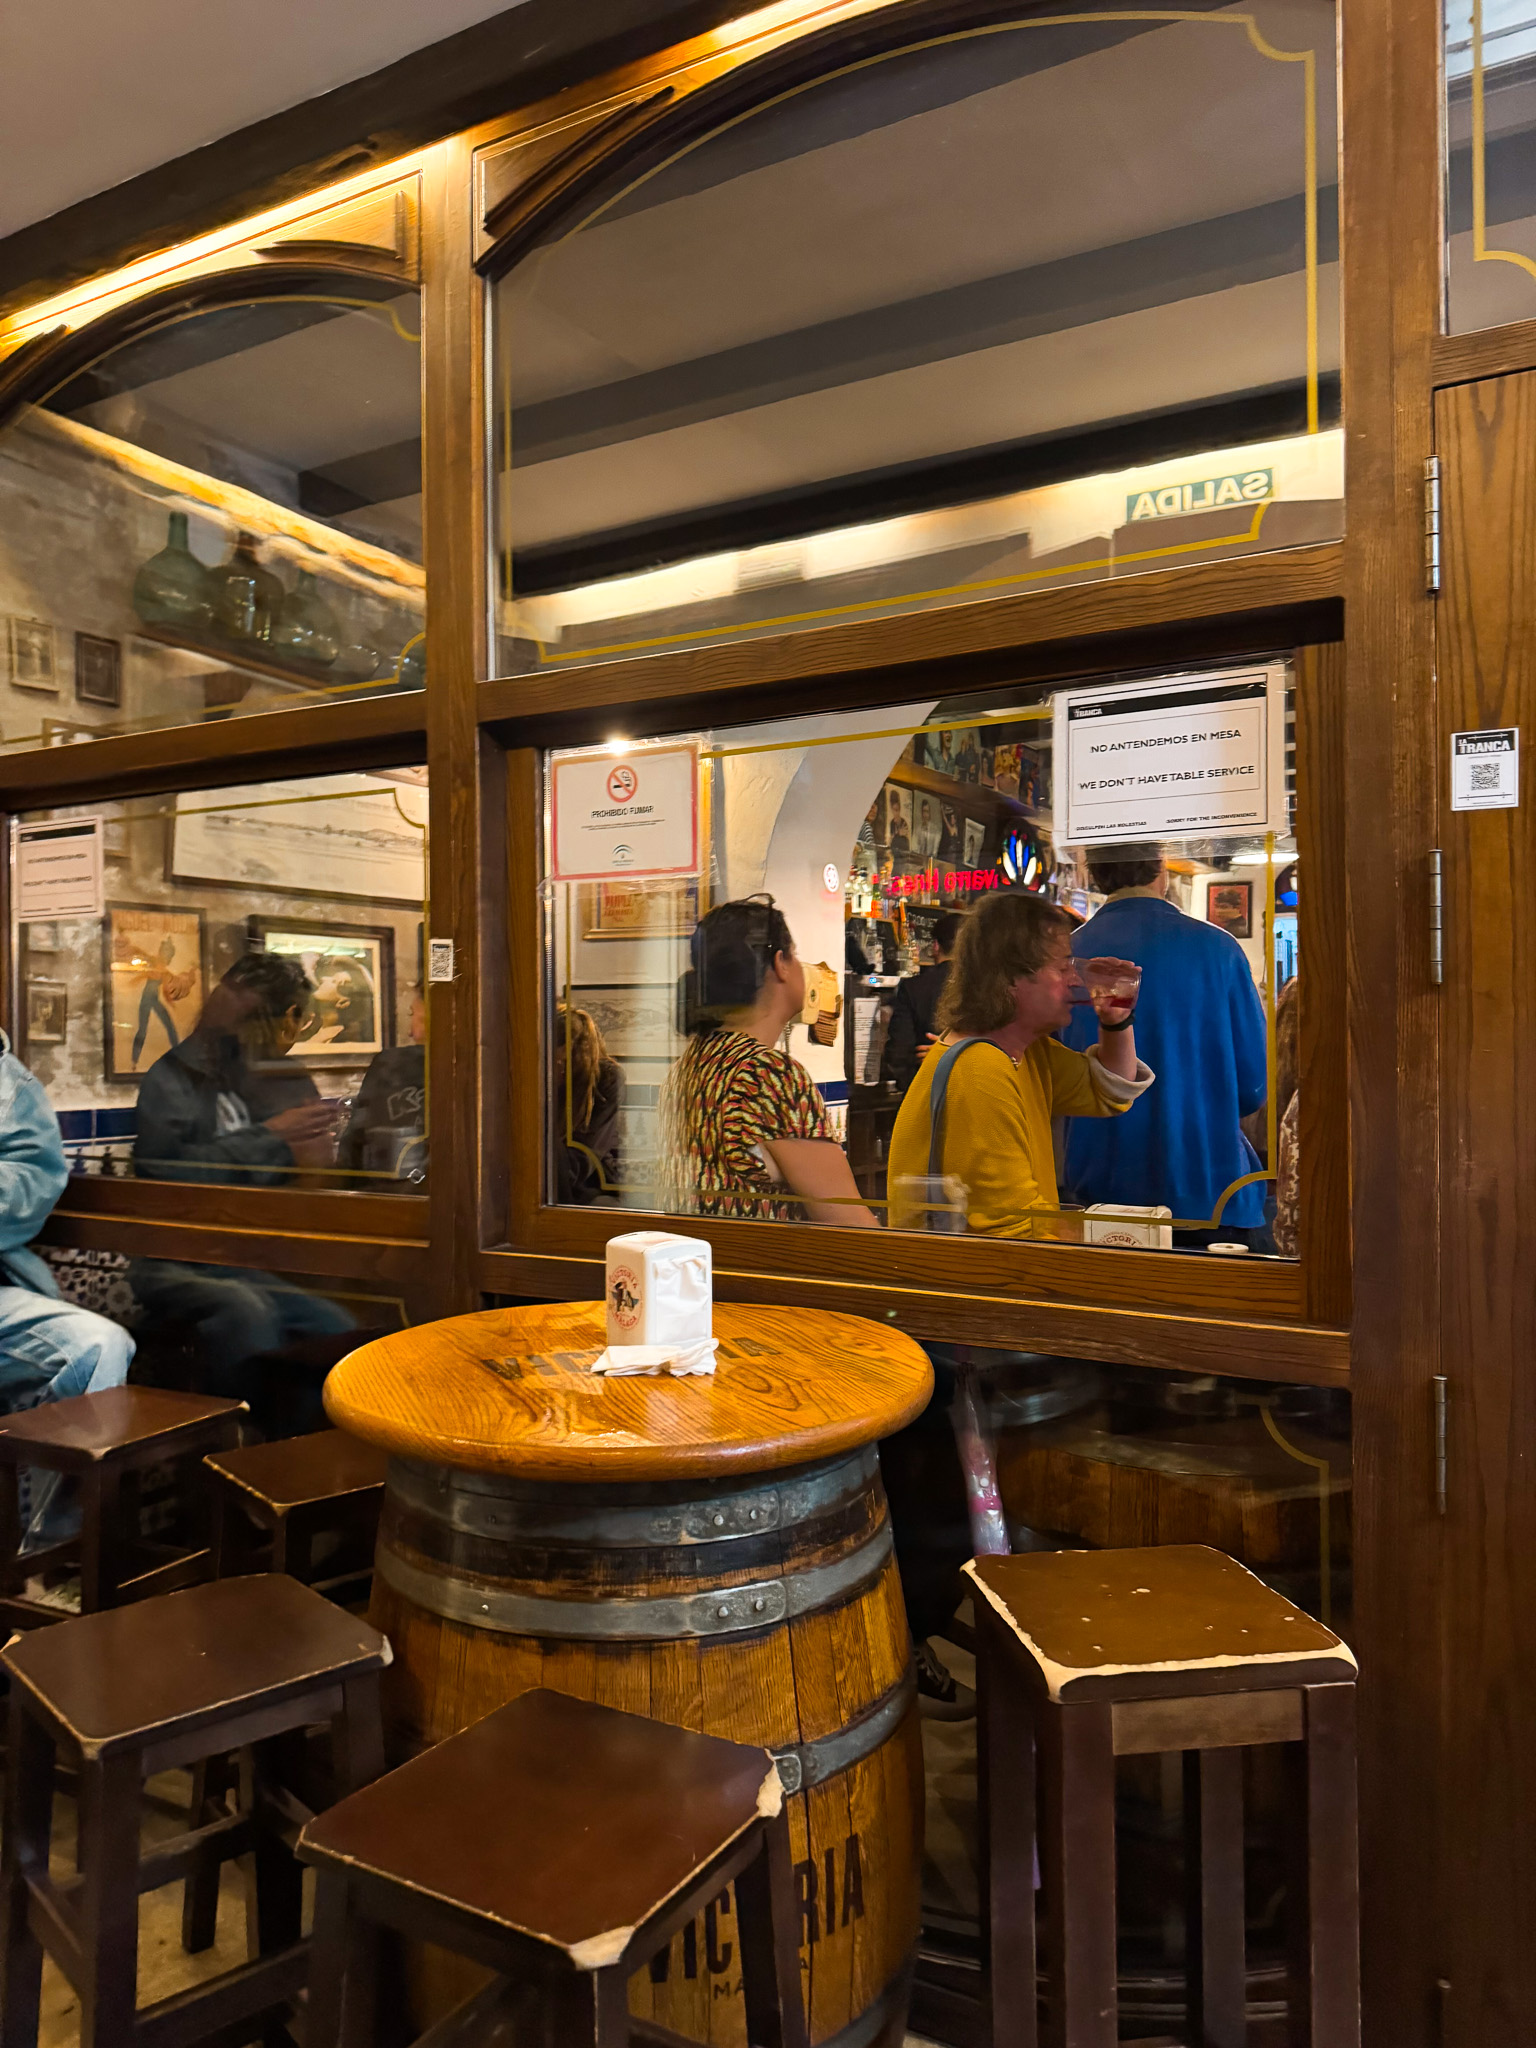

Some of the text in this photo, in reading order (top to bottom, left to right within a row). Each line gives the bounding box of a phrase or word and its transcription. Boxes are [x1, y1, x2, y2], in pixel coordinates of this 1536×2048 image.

[1090, 729, 1241, 753] NO ANTENDEMOS EN MESA
[1458, 740, 1511, 754] TRANCA
[1078, 765, 1255, 790] WE DON'T HAVE TABLE SERVICE
[591, 805, 654, 818] PROHIBIDO FUMAR
[1102, 1235, 1137, 1246] ICTORI
[650, 1833, 865, 1983] ICRIA
